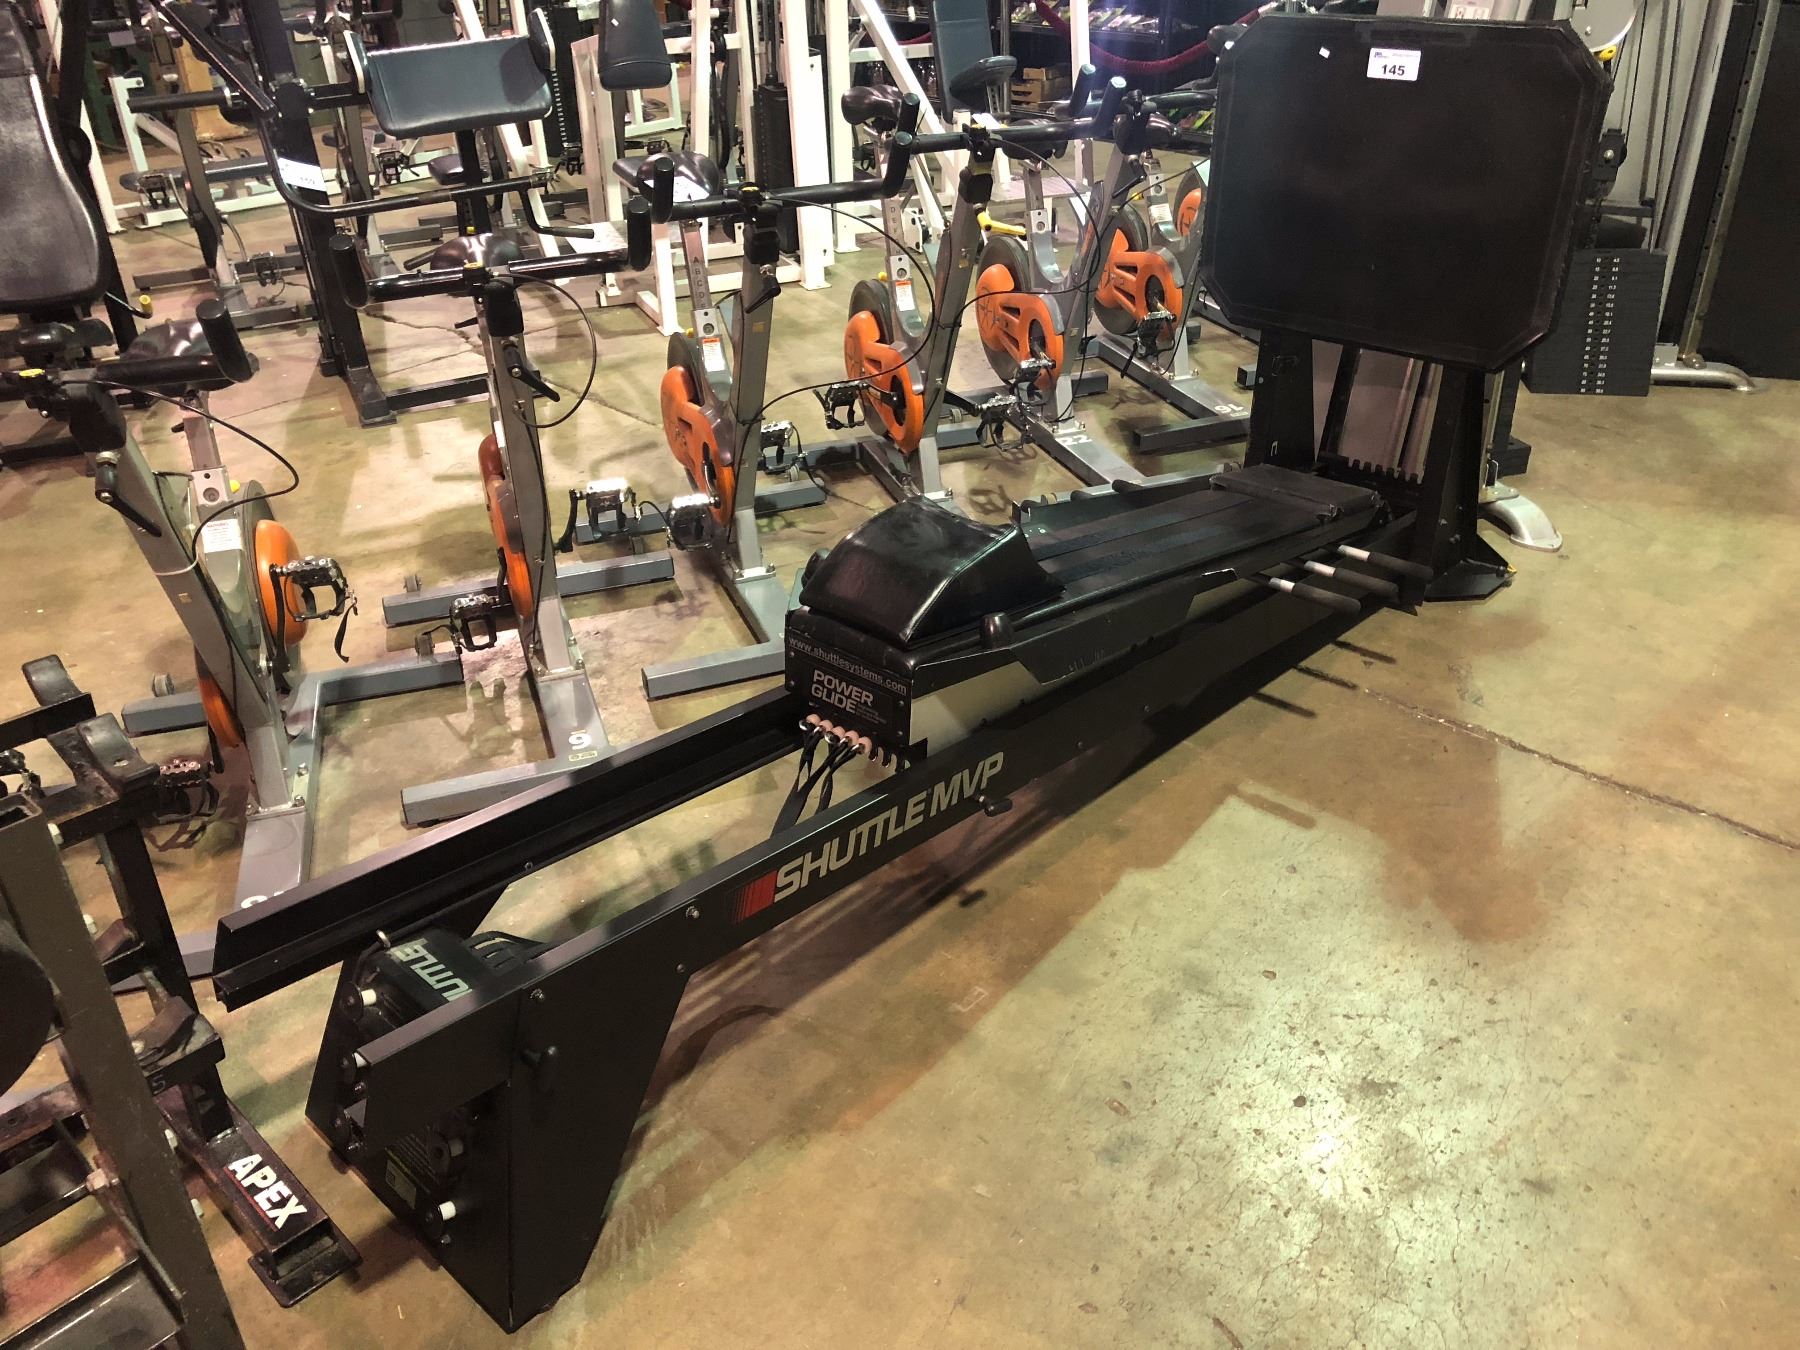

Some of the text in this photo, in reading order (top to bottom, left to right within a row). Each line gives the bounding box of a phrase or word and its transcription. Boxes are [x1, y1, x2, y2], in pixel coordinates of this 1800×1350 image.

[1381, 63, 1406, 77] 145
[788, 636, 908, 696] www.shuttlesystems.com
[813, 668, 874, 707] POWER
[811, 683, 858, 714] GLIDE
[773, 751, 1005, 904] SHUTTLE MVP
[391, 943, 473, 1003] UTTLE
[227, 1153, 309, 1230] APEX
